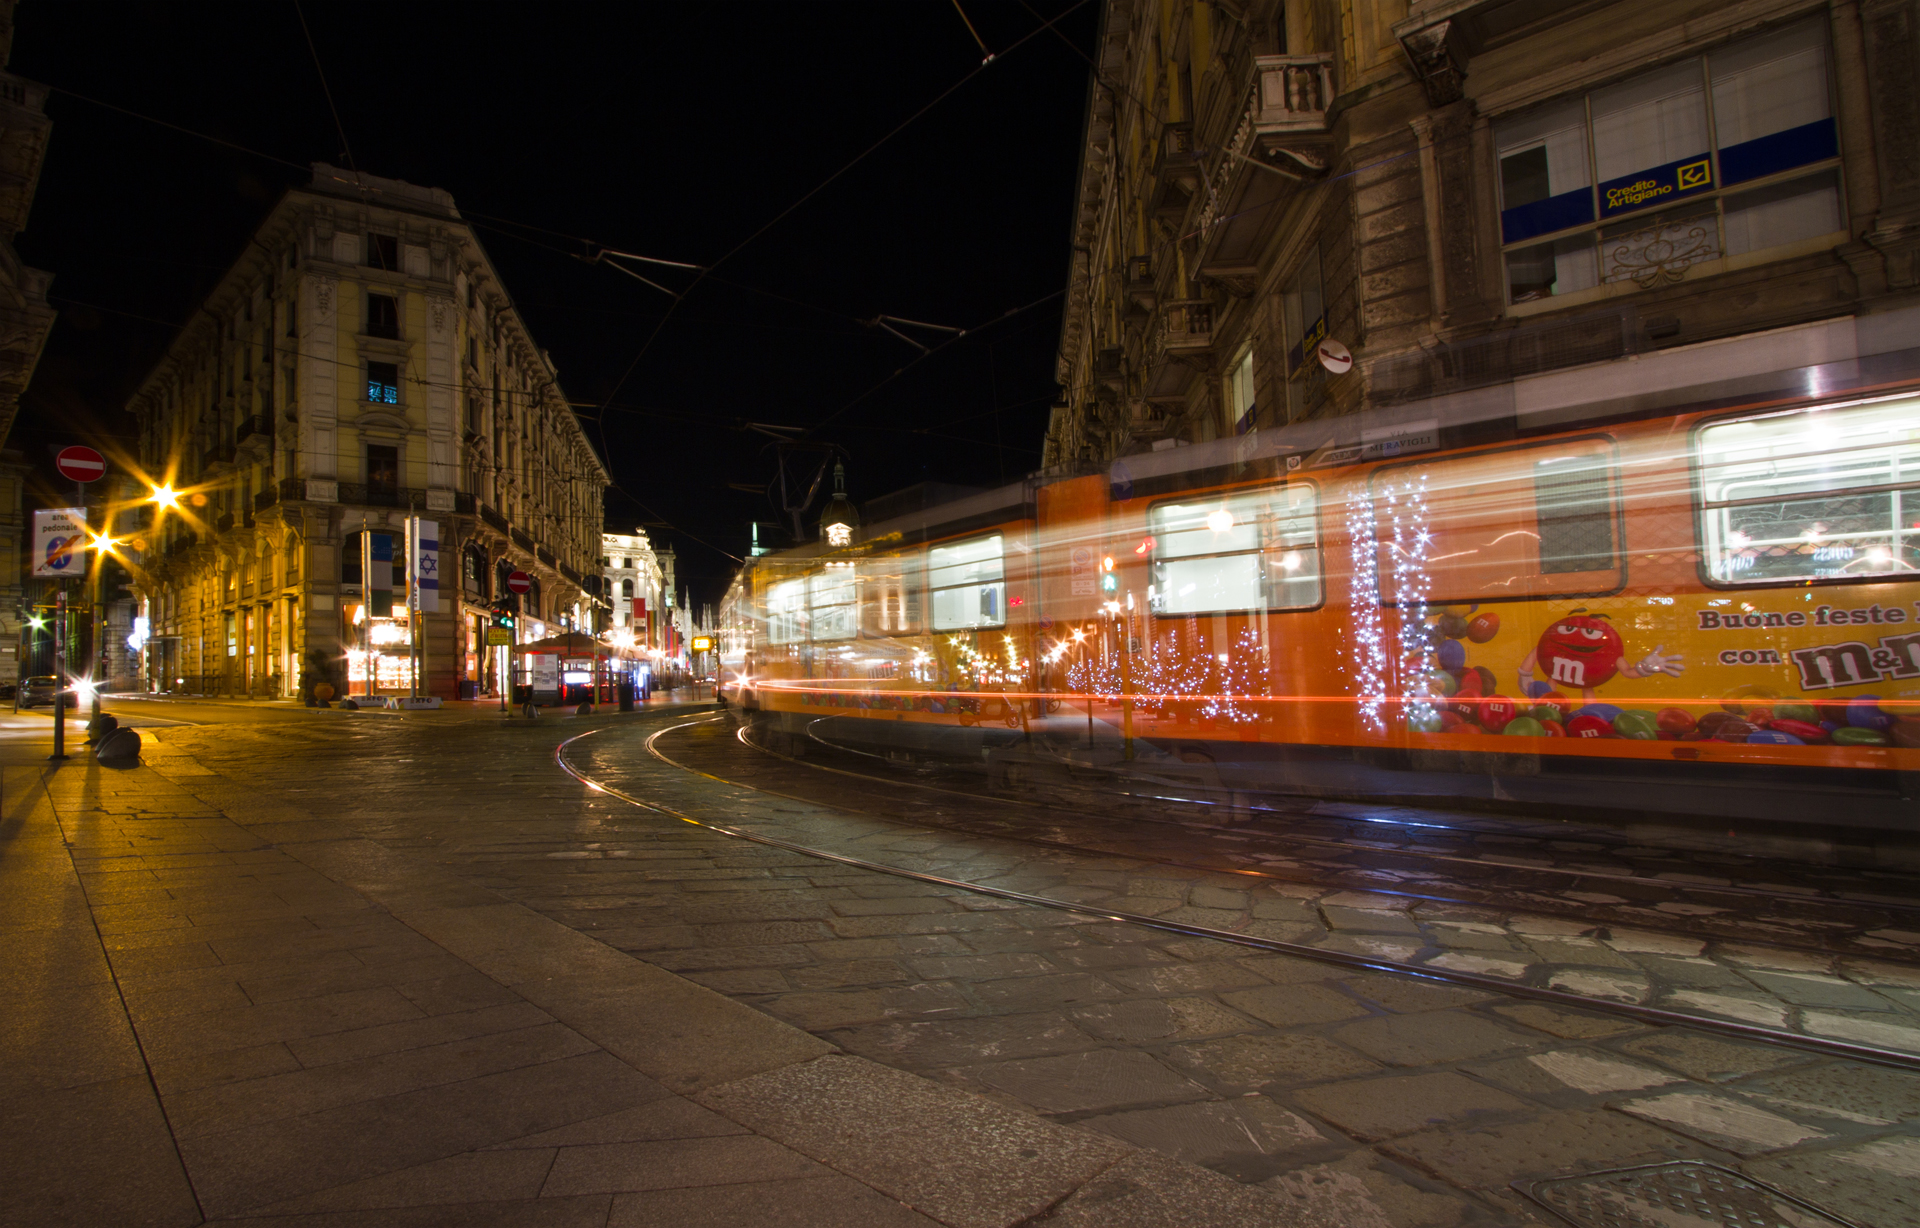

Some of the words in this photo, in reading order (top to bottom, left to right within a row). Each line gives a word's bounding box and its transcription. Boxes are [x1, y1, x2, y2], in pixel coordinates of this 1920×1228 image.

[1606, 179, 1657, 200] Credito
[1608, 184, 1673, 209] Artigiano
[1391, 429, 1409, 437] VIA
[1370, 436, 1432, 453] MERAVIGLI
[1330, 450, 1352, 461] ATM
[42, 523, 78, 533] pedonale
[1698, 609, 1806, 630] Buone
[1814, 604, 1907, 627] feste
[1718, 648, 1782, 666] con
[1551, 656, 1585, 686] m
